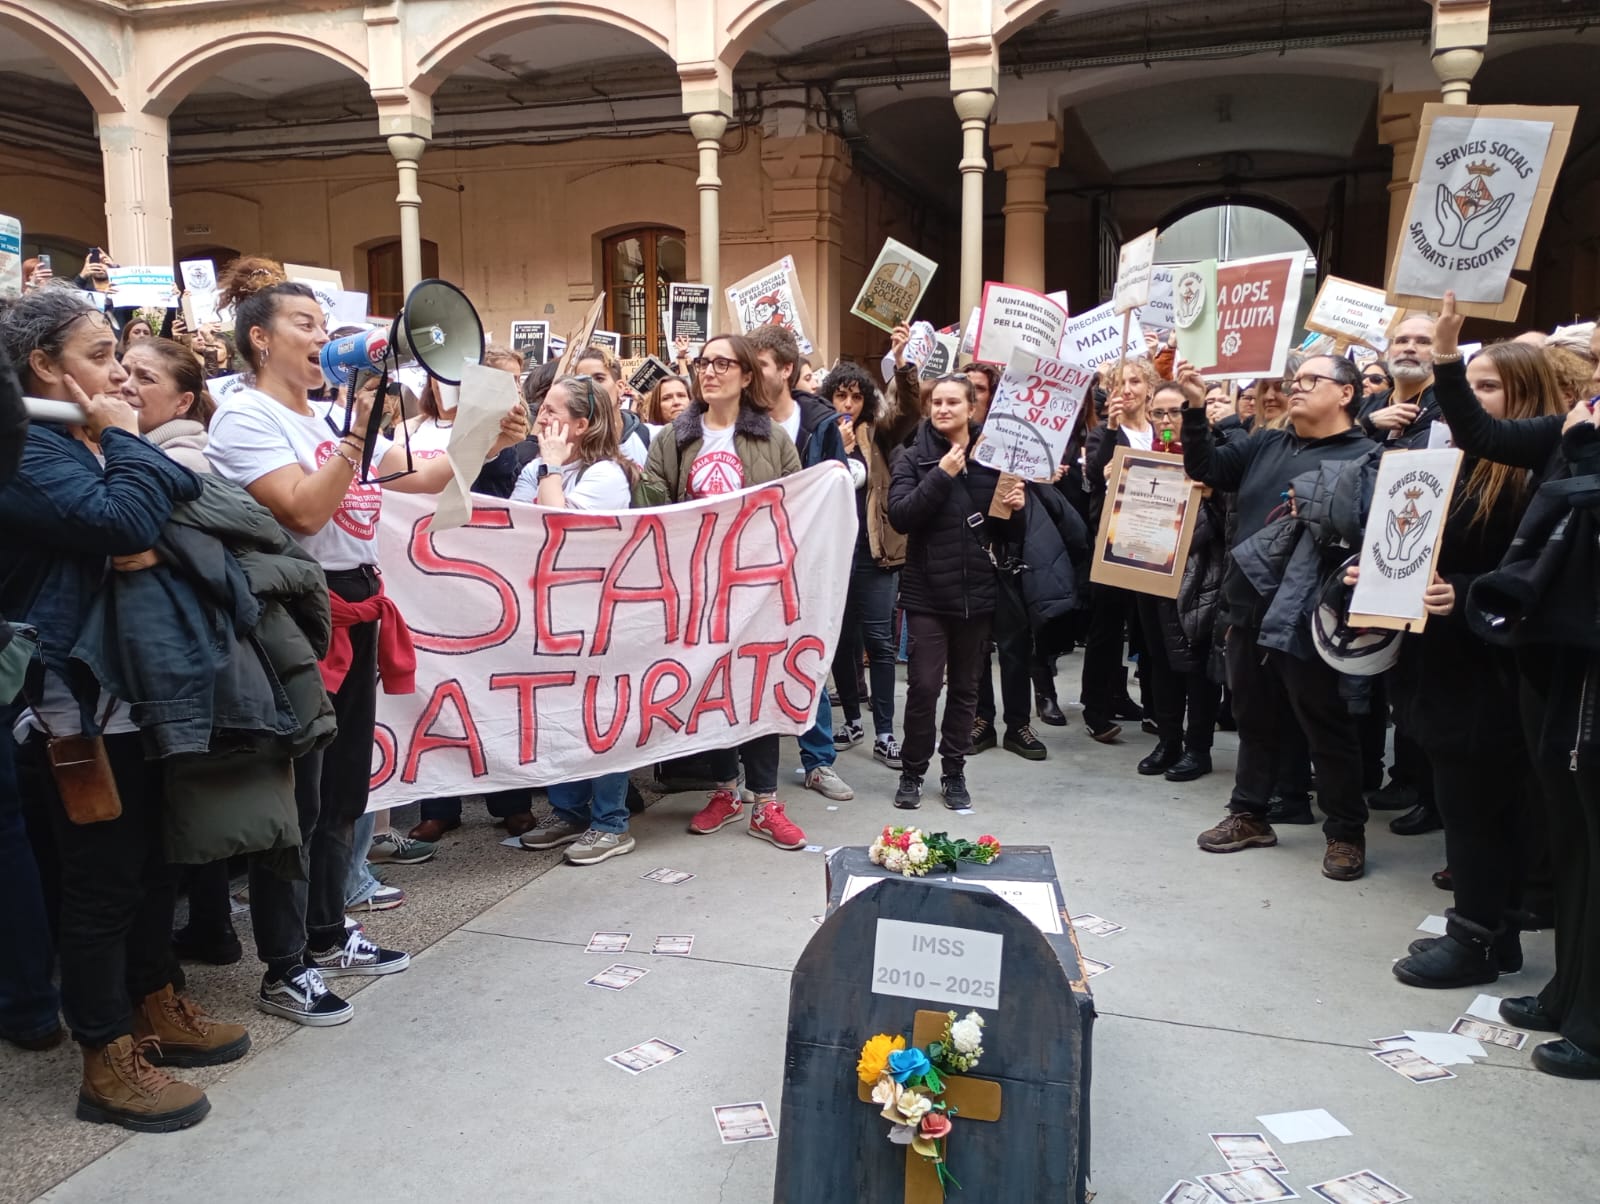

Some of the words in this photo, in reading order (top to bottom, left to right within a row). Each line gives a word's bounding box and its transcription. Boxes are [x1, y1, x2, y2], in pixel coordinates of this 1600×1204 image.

[1435, 140, 1486, 170] SERVEIS
[1489, 141, 1533, 179] SOCIALS
[1410, 221, 1446, 268] SATURATS
[1449, 258, 1454, 270] i
[1456, 235, 1517, 271] ESGOTATS
[739, 284, 760, 300] SERVEIS
[760, 272, 785, 288] SOCIALS
[875, 277, 913, 302] SERVEIS
[1153, 273, 1173, 283] AJU
[689, 296, 707, 304] MORT
[740, 298, 748, 306] DE
[749, 279, 786, 302] BARCELONA
[872, 287, 909, 311] SOCIALS
[997, 296, 1043, 314] AJUNTAMENT
[1217, 286, 1227, 305] A
[1231, 280, 1272, 302] OPSE
[1344, 297, 1384, 313] PRECARIETAT
[1005, 308, 1028, 318] ESTEM
[1068, 306, 1116, 334] PRECARIET
[1224, 306, 1275, 330] LLUITA
[1341, 317, 1370, 329] QUALITAT
[993, 318, 1010, 327] PER
[1012, 321, 1023, 329] LA
[1025, 323, 1051, 341] DIGNITAT
[1076, 325, 1119, 352] MATA
[1035, 358, 1090, 388] VOLEM
[1015, 375, 1058, 407] 35
[1024, 406, 1046, 423] SÍ
[1040, 418, 1049, 426] o
[1049, 414, 1072, 432] SÍ
[1388, 470, 1417, 498] SERVEIS
[1418, 470, 1444, 498] SOCIALS
[406, 484, 800, 656] SEAIA
[1372, 542, 1392, 579] SATURATS
[1398, 545, 1431, 579] ESGOTATS
[912, 934, 965, 957] IMSS
[877, 967, 925, 988] 2010
[946, 976, 995, 998] 2025
